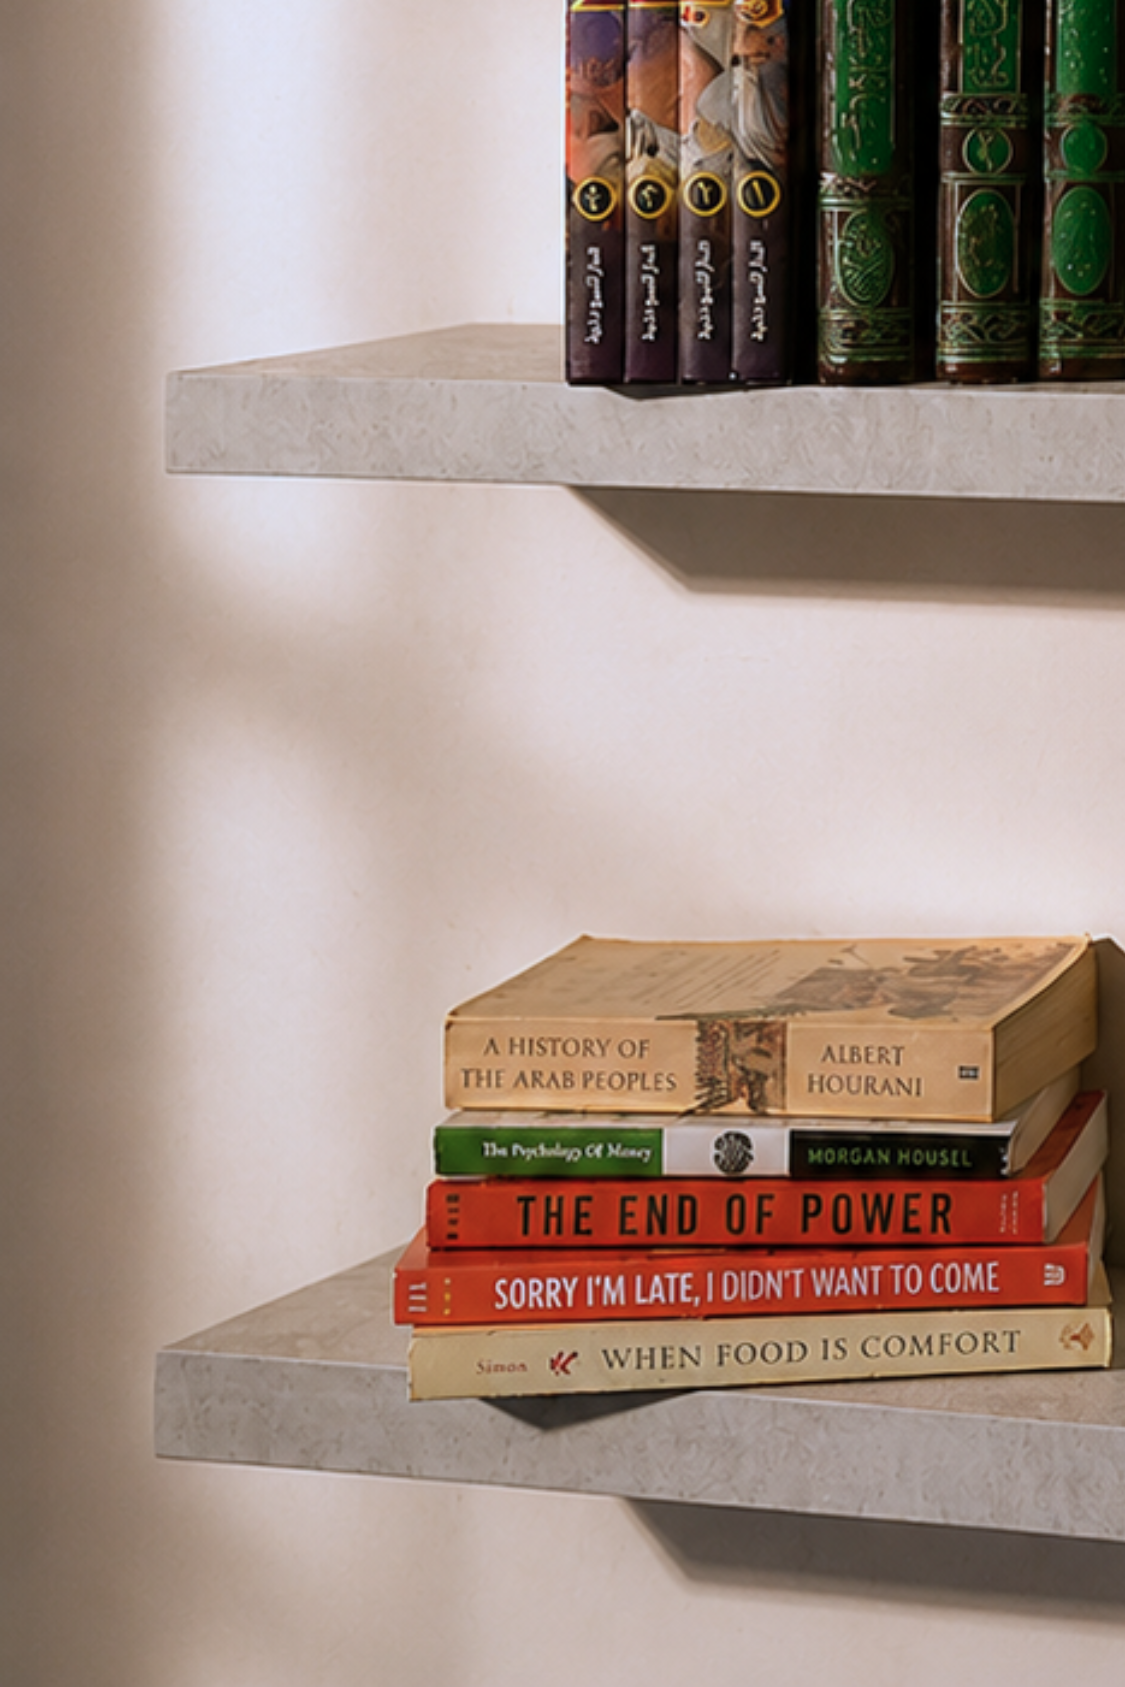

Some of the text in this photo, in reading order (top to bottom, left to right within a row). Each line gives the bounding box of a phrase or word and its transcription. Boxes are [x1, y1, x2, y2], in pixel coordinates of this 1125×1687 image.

[483, 1037, 650, 1059] A HISTORY OF
[820, 1045, 905, 1066] ALBERT
[462, 1068, 677, 1091] THE ARAB PEOPLES
[808, 1073, 922, 1097] HOURANI
[482, 1142, 508, 1158] The
[585, 1142, 603, 1159] Of
[608, 1142, 652, 1163] Money
[808, 1147, 973, 1168] MORGAN HOUSEL
[516, 1195, 594, 1237] THE
[618, 1193, 698, 1237] END
[725, 1192, 775, 1236] OF
[801, 1192, 953, 1235] POWER
[494, 1261, 1000, 1311] SORRY I'M LATE, I DIDN'T WANT TO COME
[476, 1330, 1021, 1375] Simon WHEN FOOD IS COMFORT
